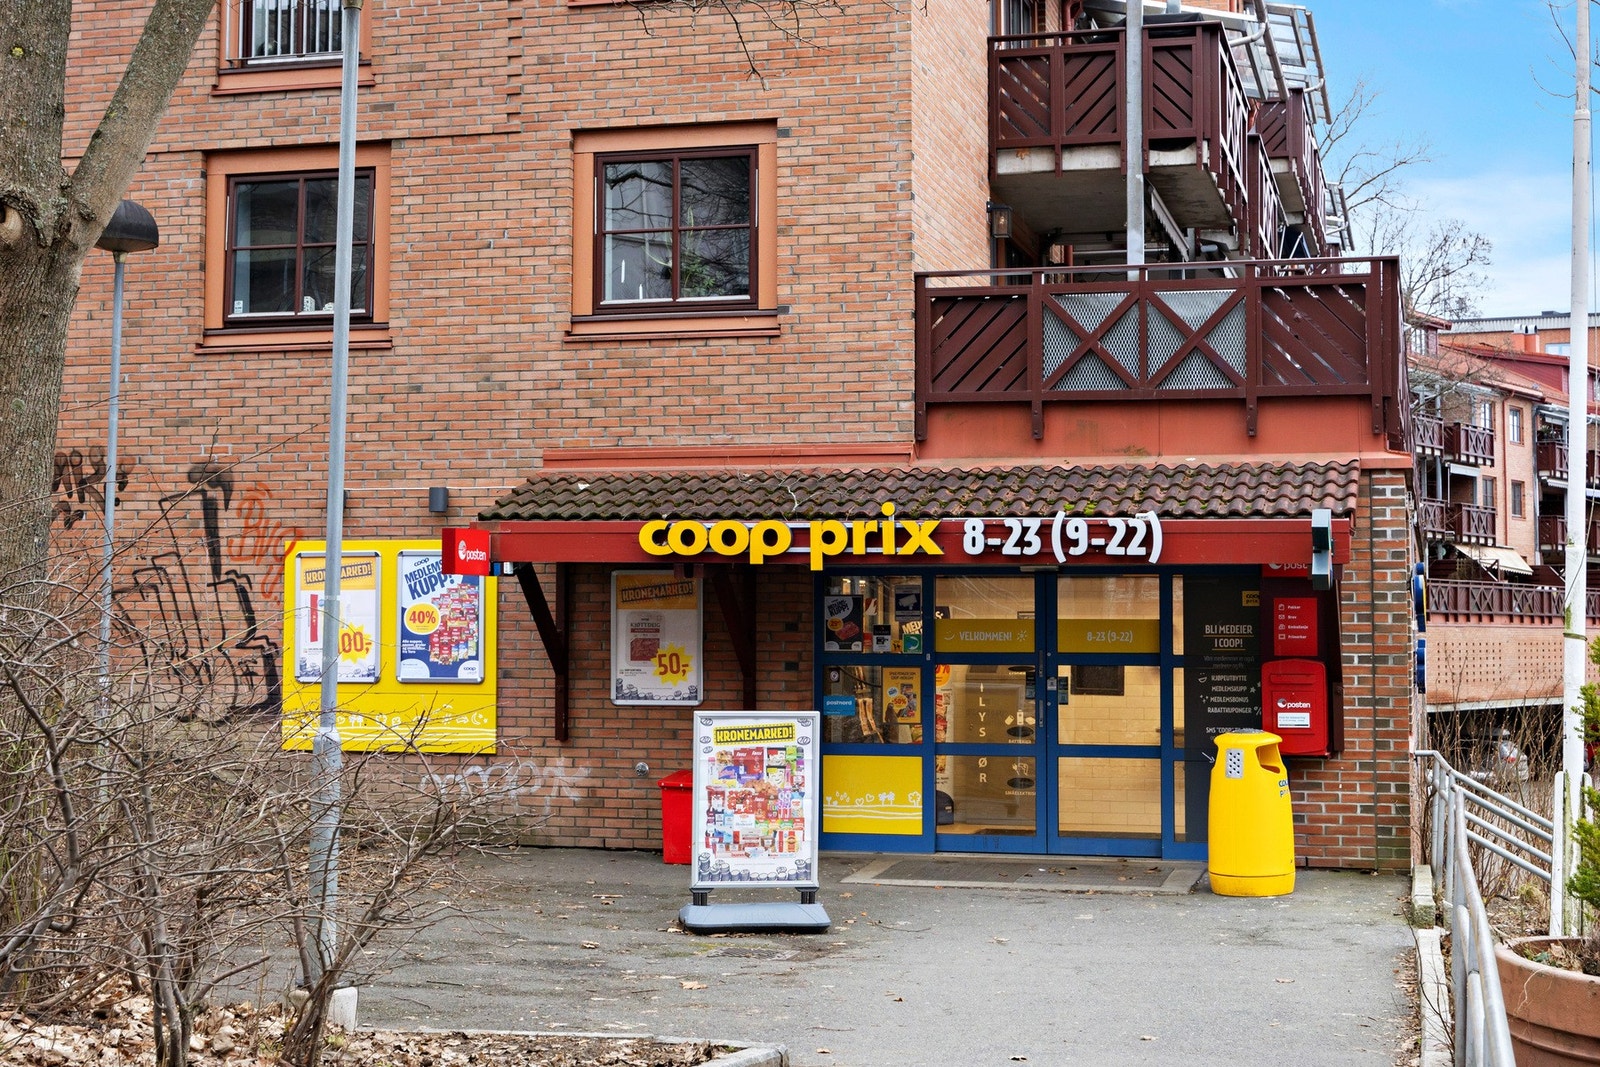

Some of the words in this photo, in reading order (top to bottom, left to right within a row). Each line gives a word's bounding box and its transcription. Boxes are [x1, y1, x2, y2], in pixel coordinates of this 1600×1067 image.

[638, 519, 792, 564] coop
[810, 501, 944, 571] prix
[963, 518, 1042, 557] 8-23
[1051, 510, 1163, 564] (9-22)
[466, 549, 487, 562] posten
[306, 563, 372, 584] KROARKED!
[622, 582, 693, 602] KRONEMARKED!
[409, 610, 436, 624] 40%
[959, 631, 1012, 641] VELKOMMEN!
[1205, 624, 1217, 634] BLI
[1218, 624, 1253, 634] MEDEIER
[338, 632, 372, 654] 00,-
[1087, 631, 1105, 642] 8-23
[1107, 631, 1133, 643] (9-22)
[1214, 638, 1218, 648] I
[1218, 638, 1243, 648] COOP!
[658, 653, 689, 676] 50,-
[1287, 701, 1311, 710] posten
[716, 727, 793, 743] KRONEMARKED!
[978, 697, 988, 783] LYSØR
